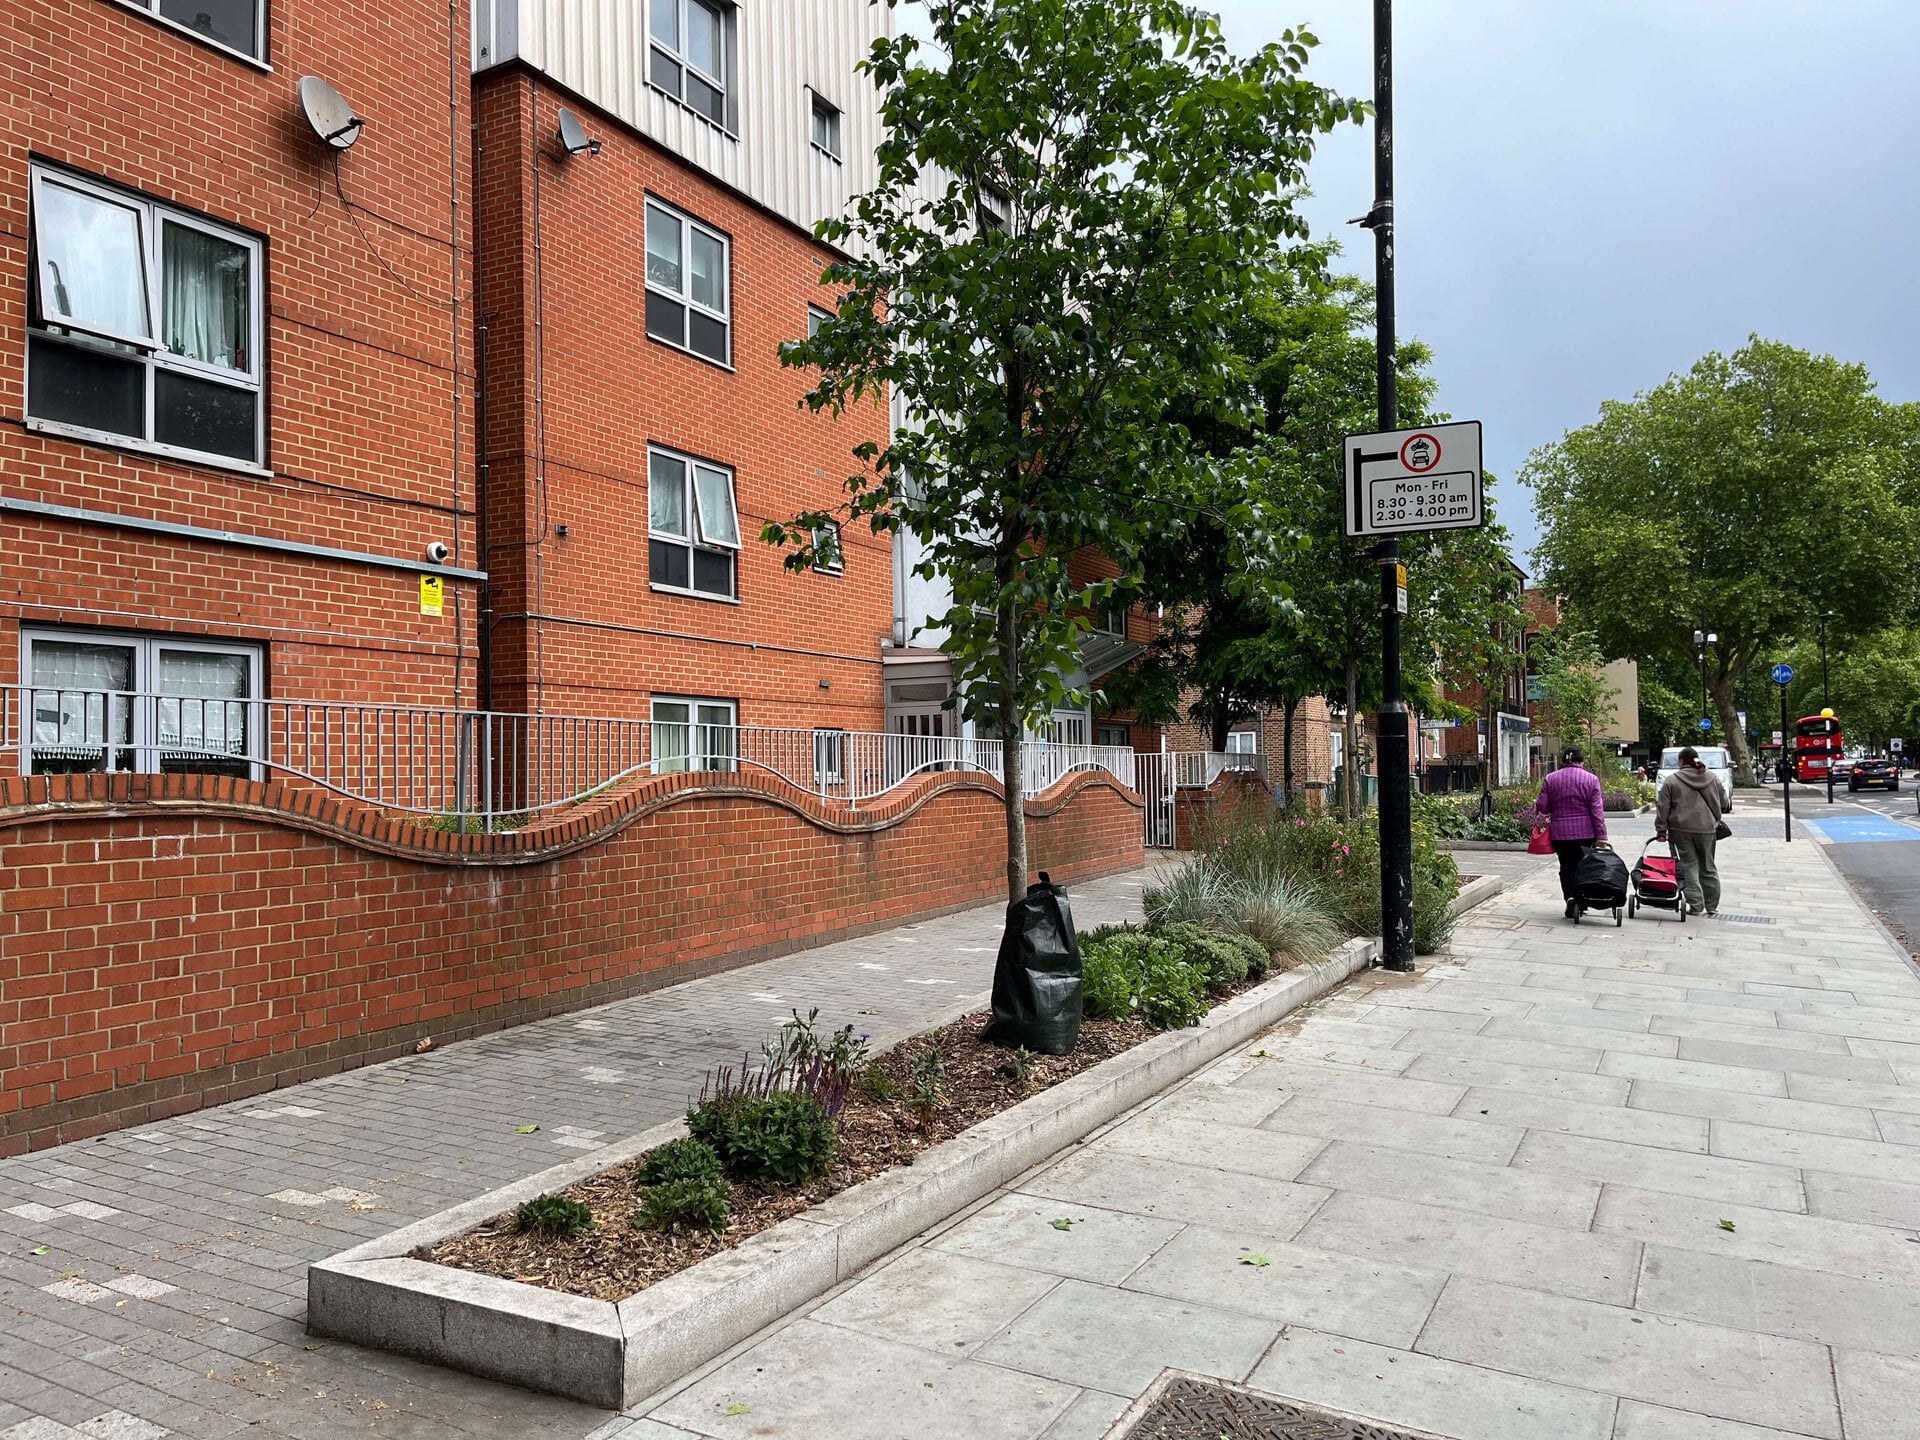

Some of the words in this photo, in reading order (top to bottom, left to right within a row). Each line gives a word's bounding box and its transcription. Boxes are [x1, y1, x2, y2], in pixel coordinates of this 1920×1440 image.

[1395, 483, 1422, 493] Mon
[1432, 480, 1448, 490] Fri
[1377, 497, 1407, 509] 8.30
[1416, 493, 1446, 505] 9.30
[1449, 493, 1468, 502] am
[1376, 510, 1406, 521] 2.30
[1415, 506, 1446, 518] 4.00
[1449, 506, 1468, 516] pm
